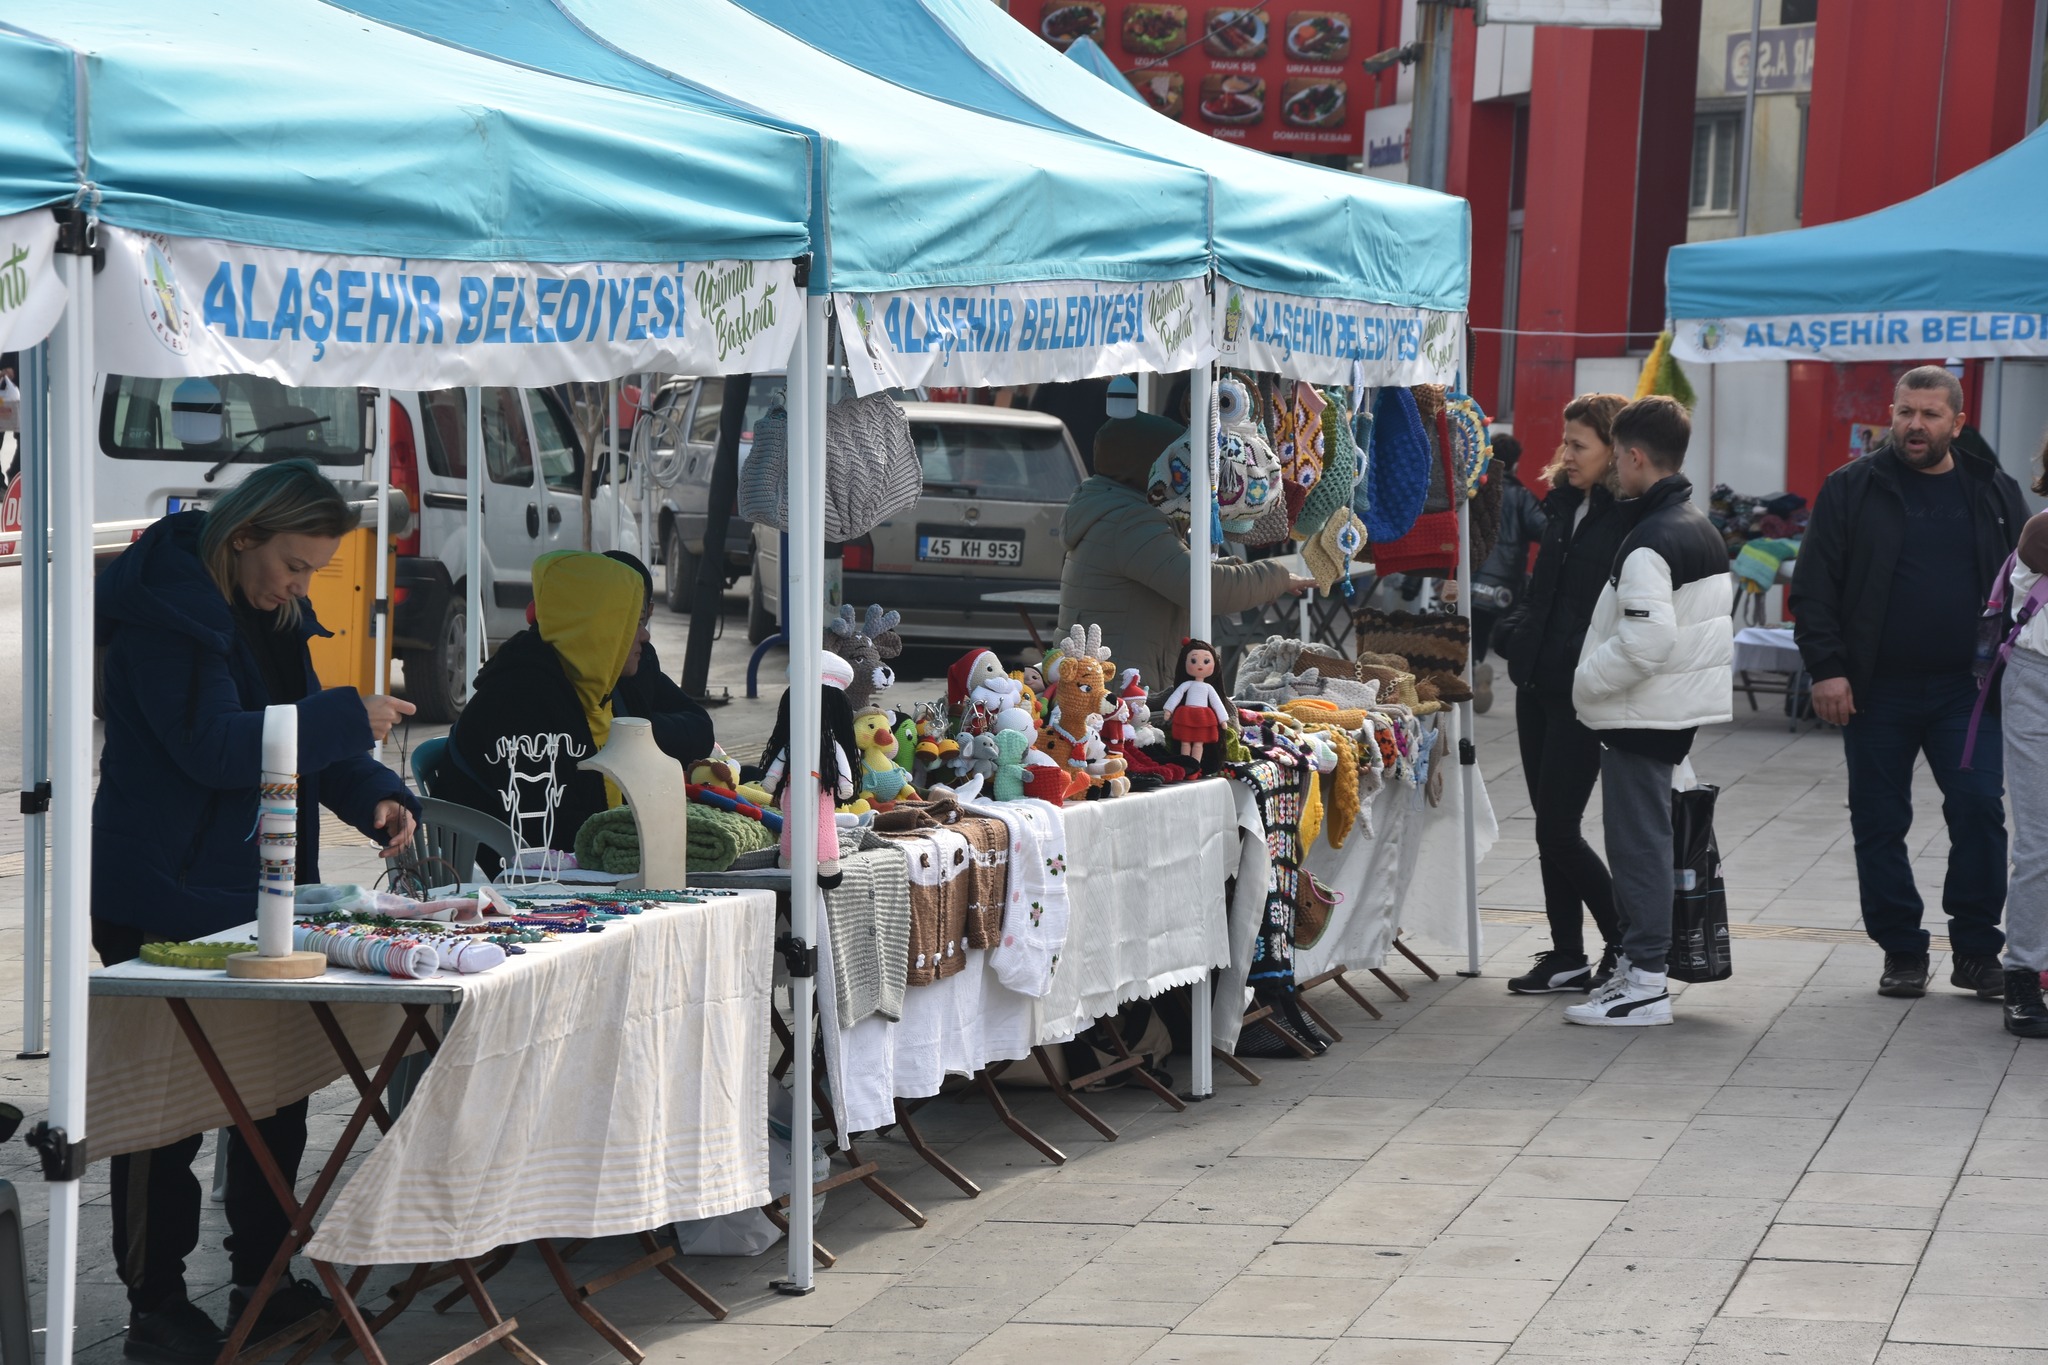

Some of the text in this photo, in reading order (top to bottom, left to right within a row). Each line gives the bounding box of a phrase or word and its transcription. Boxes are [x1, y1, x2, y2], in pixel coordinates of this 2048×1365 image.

[1211, 60, 1239, 70] TAVUK
[1312, 65, 1343, 75] KEBAP
[1273, 130, 1316, 140] DOMATES
[203, 258, 443, 363] ALAŞEHİR
[456, 261, 685, 344] BELEDİYESİ
[884, 282, 1144, 367] ALAŞEHİR BELEDİYESİ
[1742, 313, 1910, 353] ALAŞEHİR
[930, 540, 1018, 559] 45 KH 953
